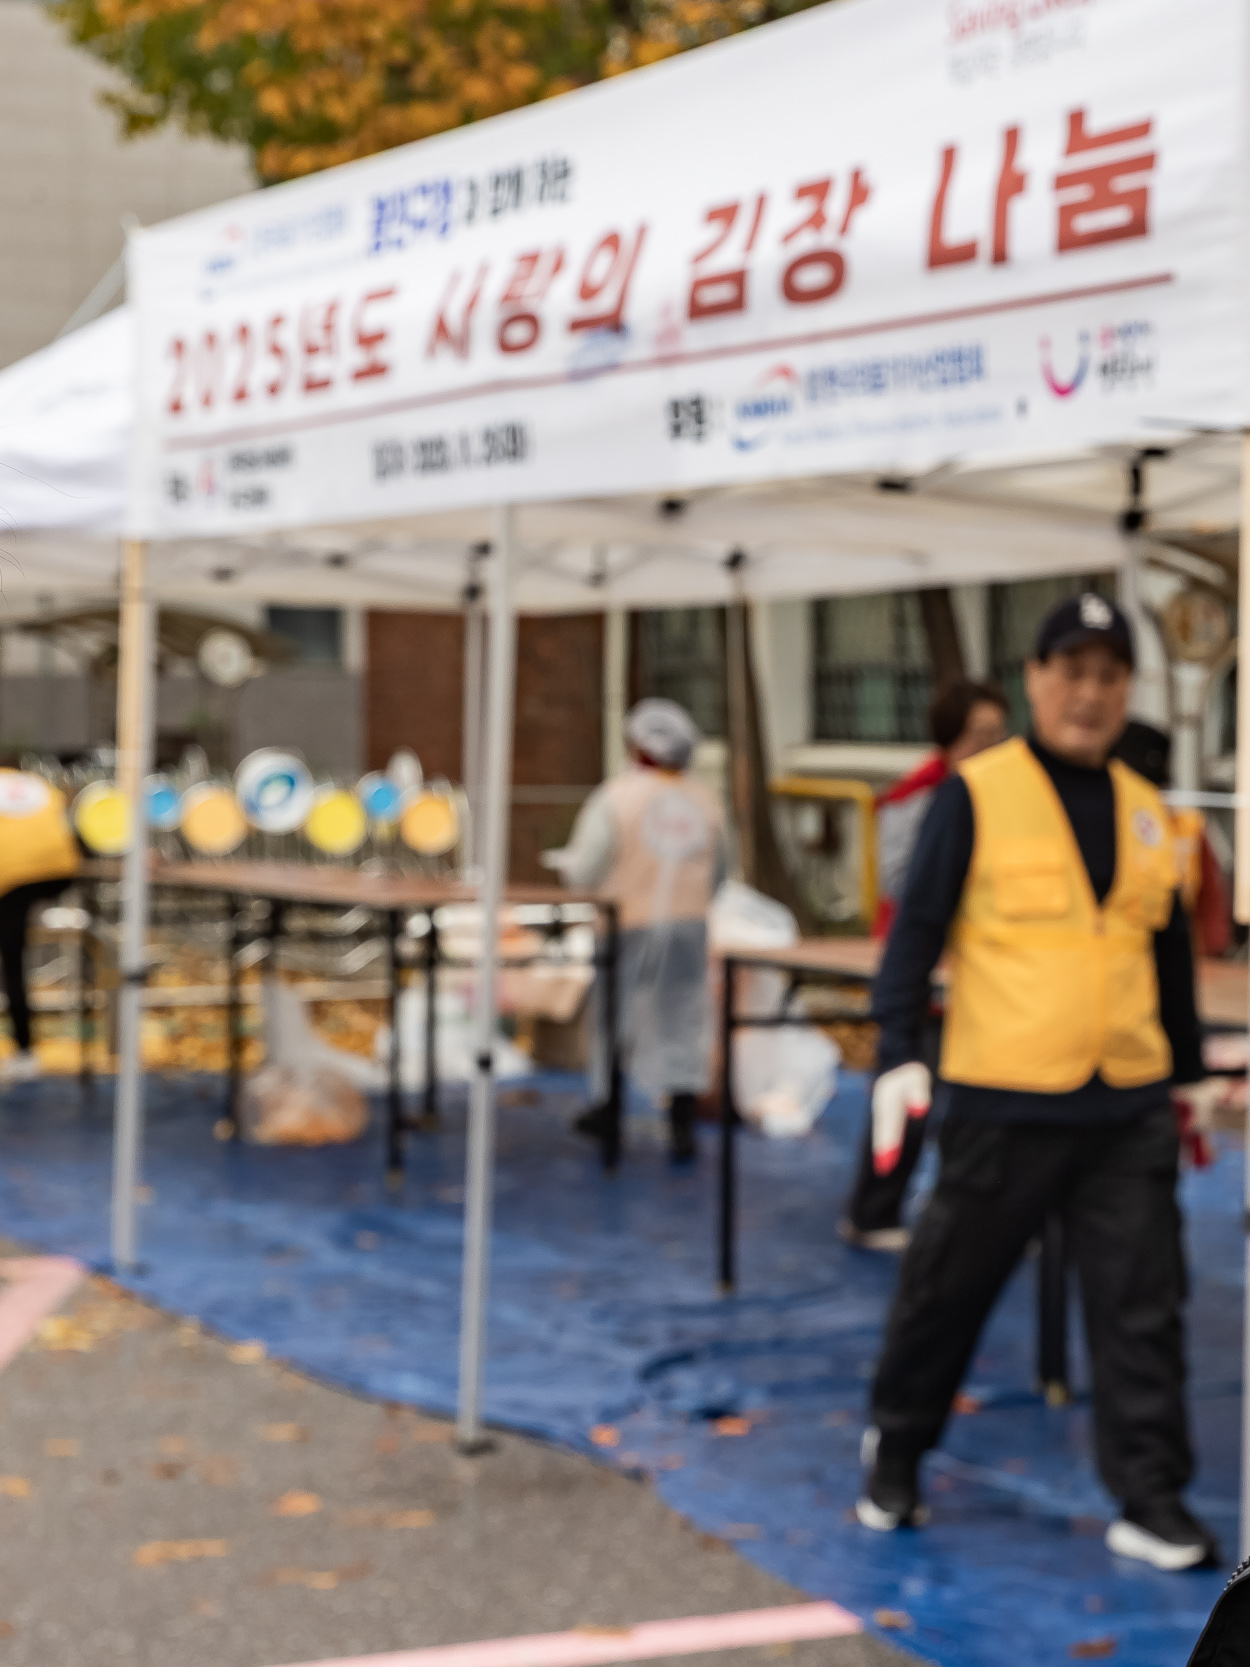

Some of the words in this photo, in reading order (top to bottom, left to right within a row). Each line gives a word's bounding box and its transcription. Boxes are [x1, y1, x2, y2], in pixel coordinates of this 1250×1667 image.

[166, 286, 397, 417] 2025년도
[424, 222, 648, 363] 사랑의
[686, 165, 873, 323] 김장
[924, 105, 1159, 274] 나눔
